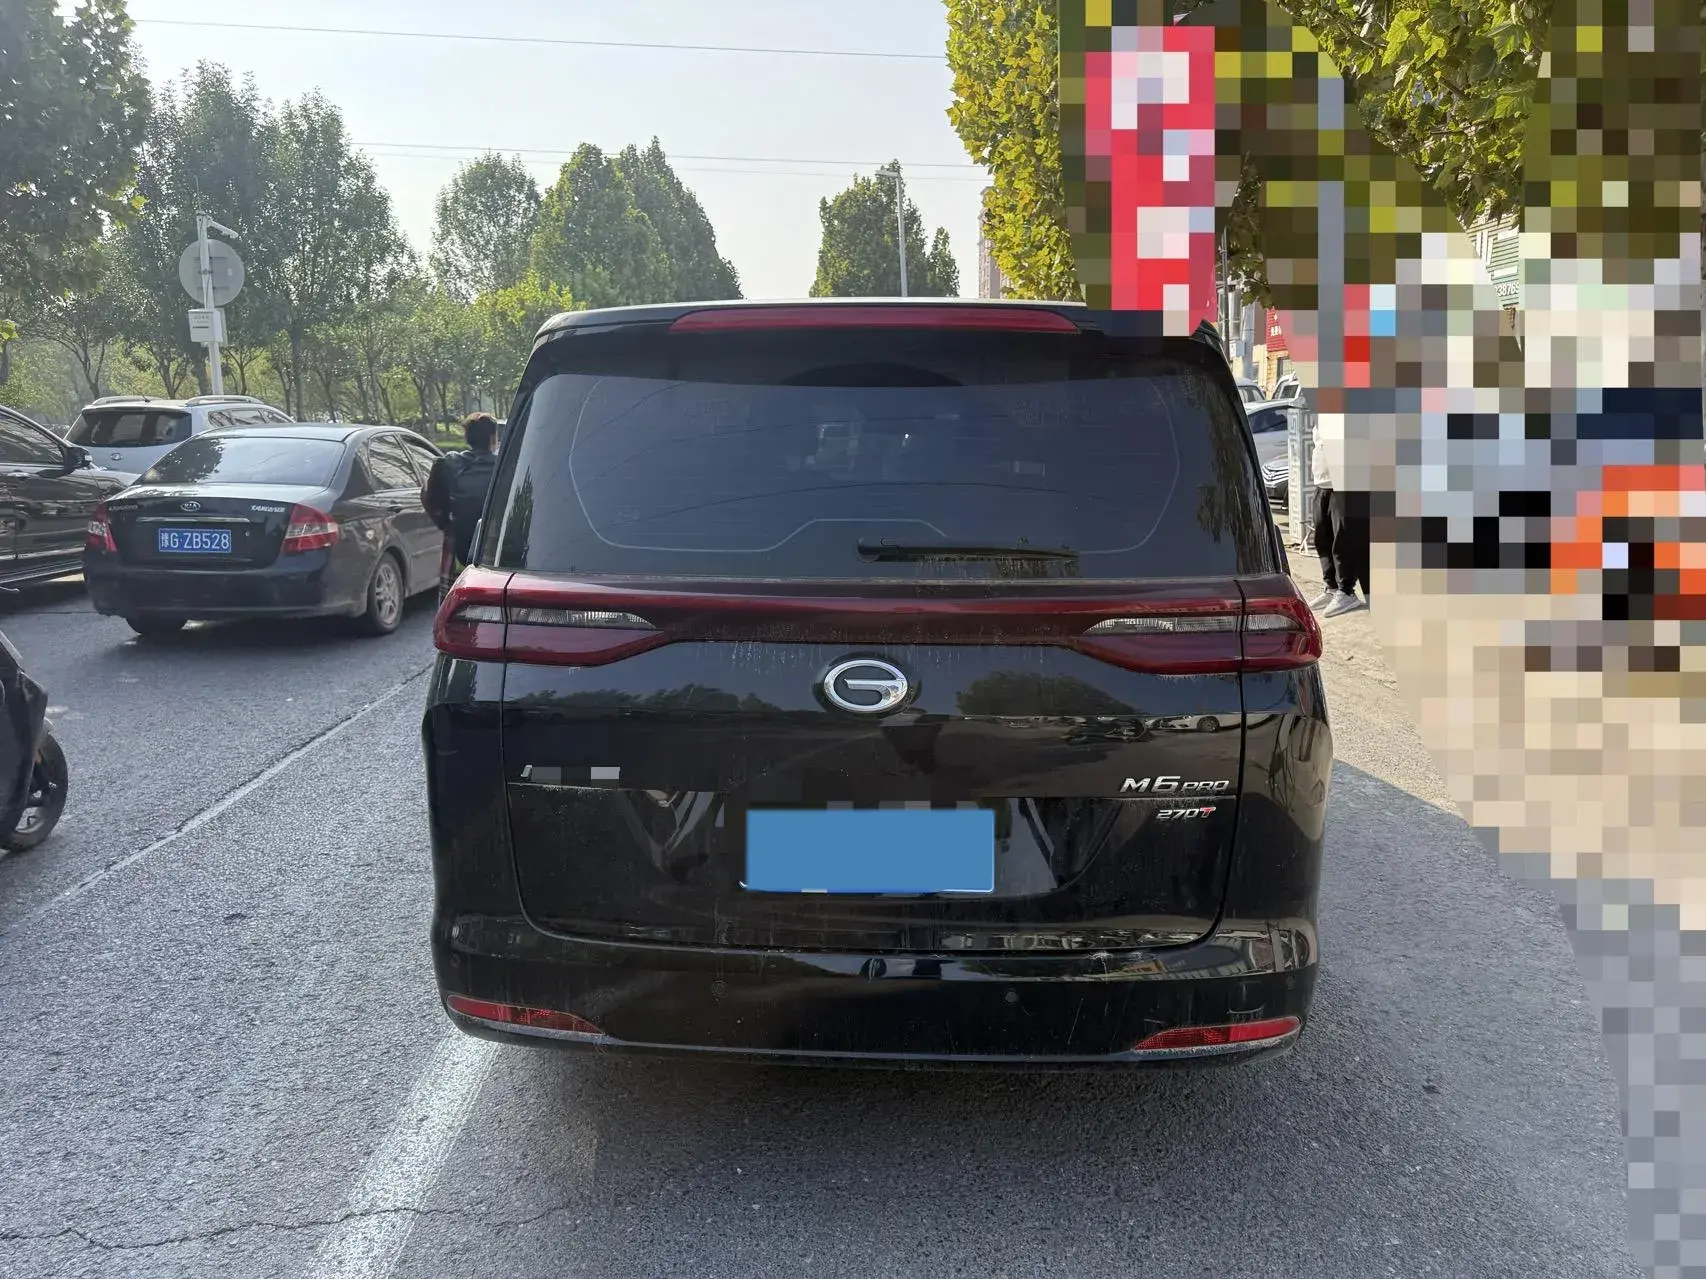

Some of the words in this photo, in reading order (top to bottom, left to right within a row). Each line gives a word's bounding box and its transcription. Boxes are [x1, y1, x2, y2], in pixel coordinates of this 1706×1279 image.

[1120, 775, 1181, 793] M6
[1181, 780, 1230, 792] PRO
[1156, 807, 1217, 819] 270T
